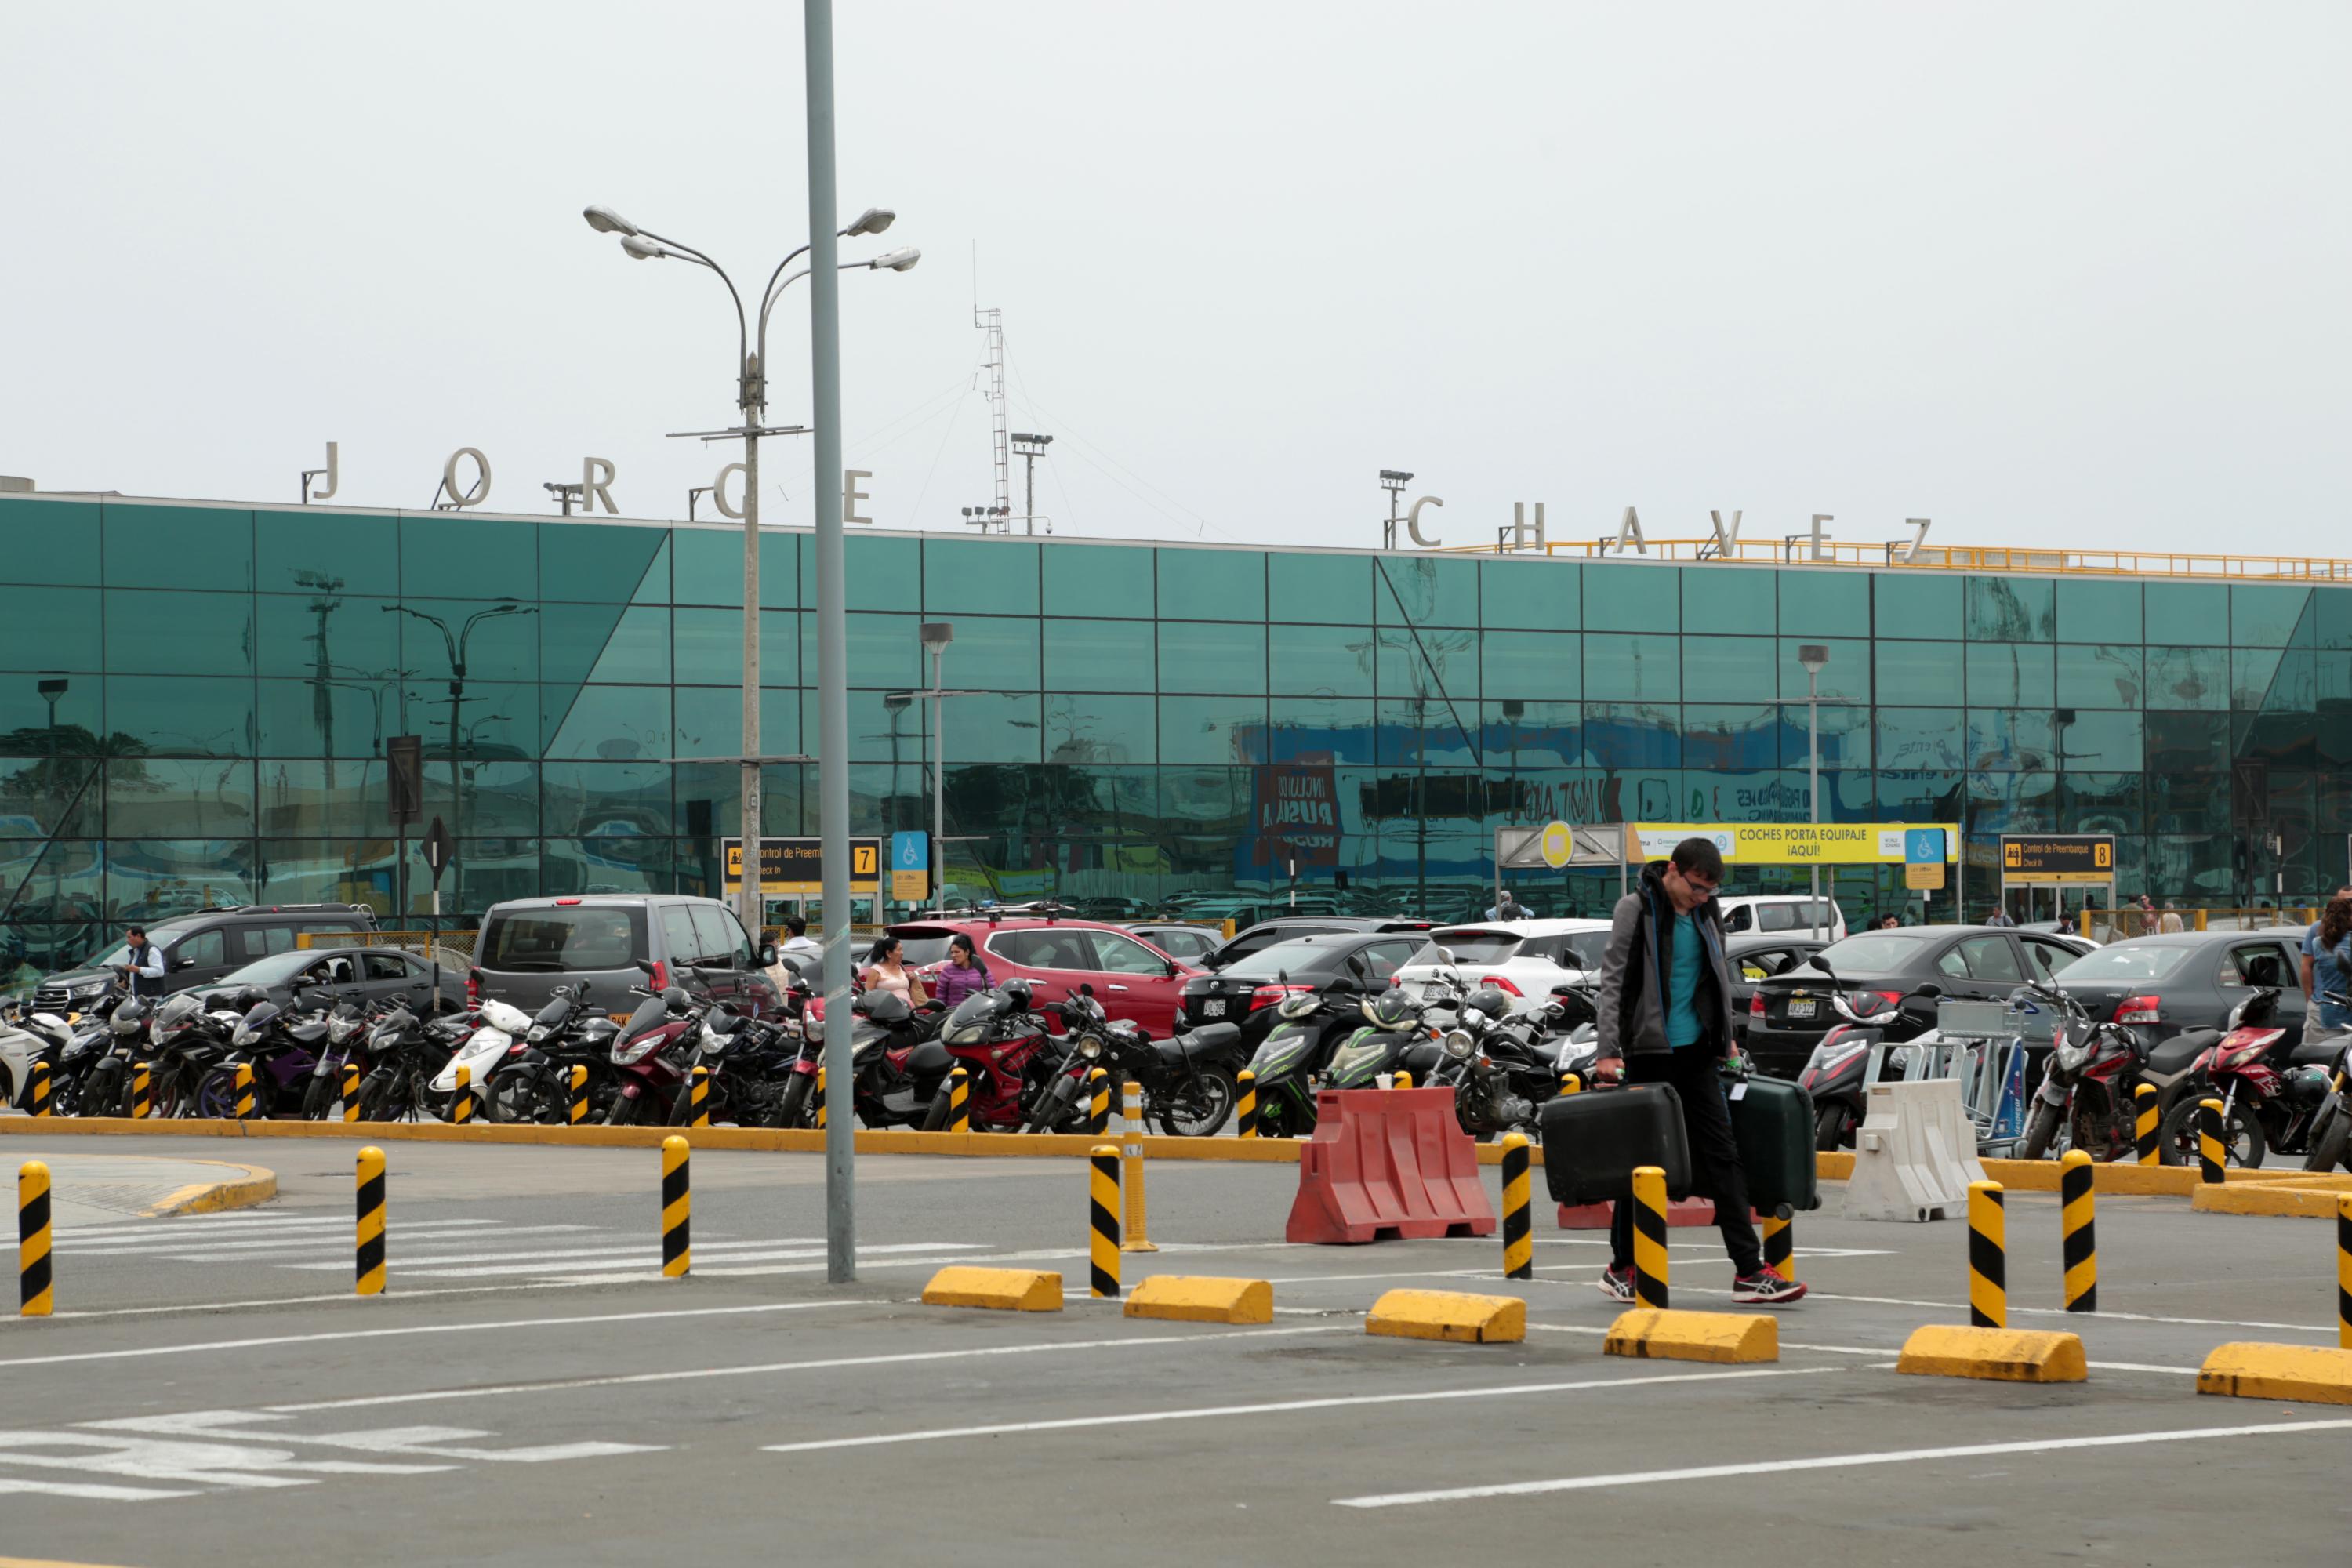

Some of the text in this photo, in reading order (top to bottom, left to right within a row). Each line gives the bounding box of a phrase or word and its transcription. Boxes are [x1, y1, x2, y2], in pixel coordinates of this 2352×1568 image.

[1407, 495, 1932, 564] CHAVEZ
[1740, 829, 1867, 841] COCHES PORTA EQUIPAJE
[760, 848, 782, 858] ontrol
[784, 848, 793, 858] de
[2024, 843, 2089, 855] Control de Preembarque
[860, 850, 869, 870] 7
[2099, 847, 2106, 864] 8
[775, 866, 781, 875] In
